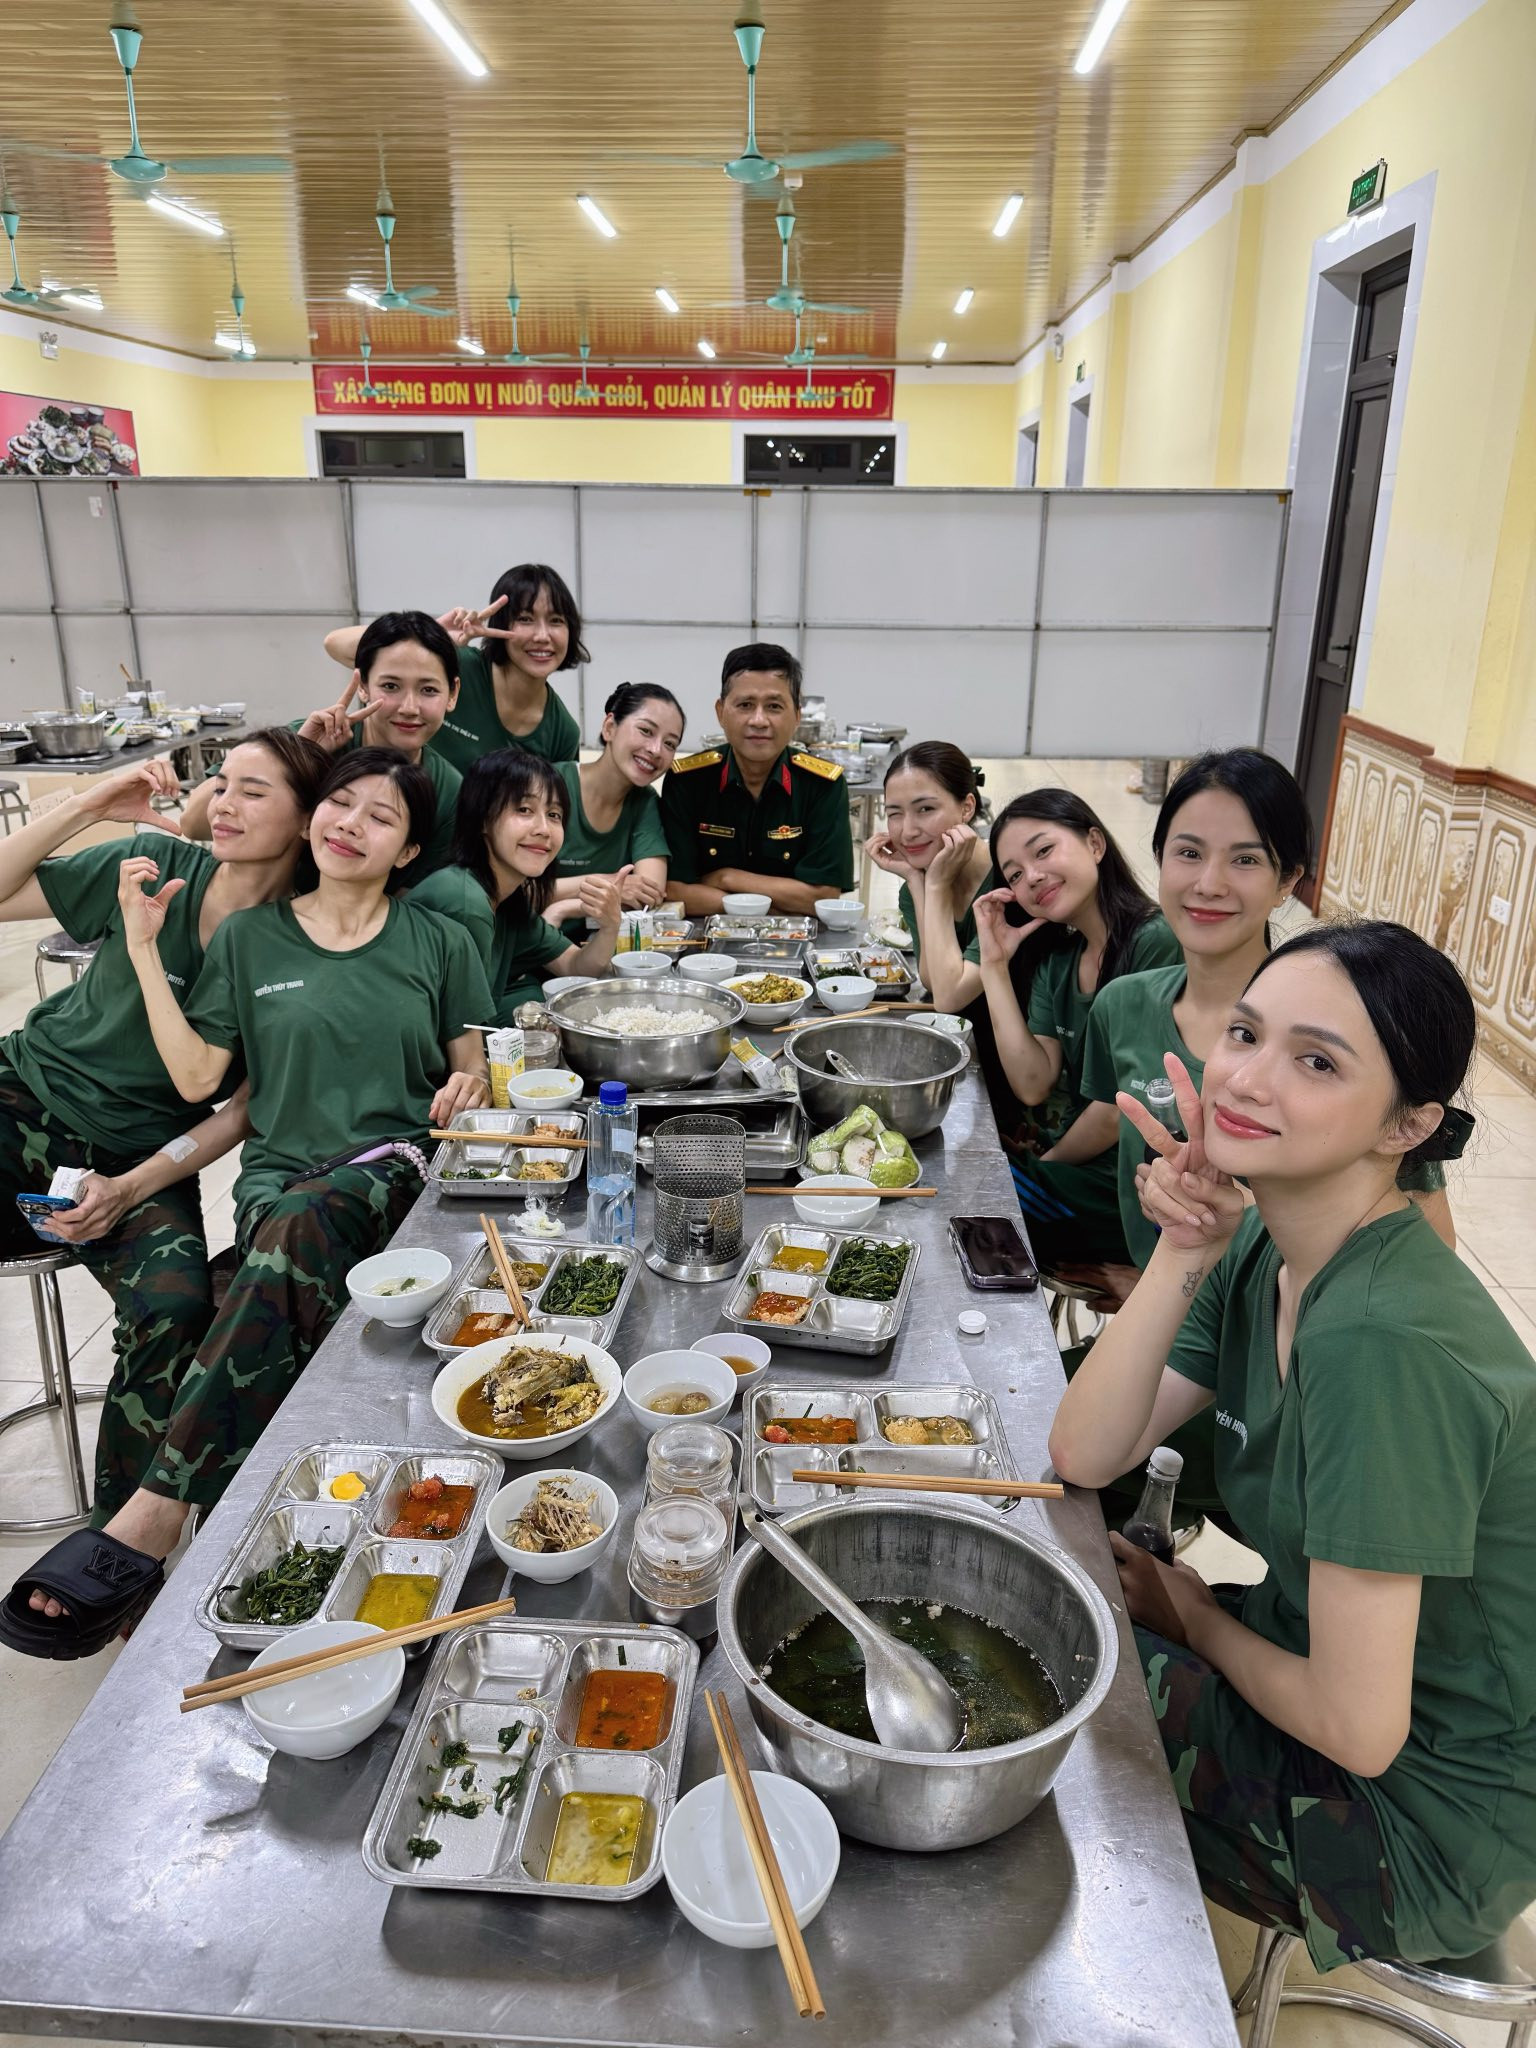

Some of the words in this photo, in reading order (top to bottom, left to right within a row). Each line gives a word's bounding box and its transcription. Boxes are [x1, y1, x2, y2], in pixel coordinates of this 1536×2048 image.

[430, 381, 470, 405] ĐƠN
[474, 382, 493, 410] VỊ
[498, 379, 543, 406] NUÔI
[653, 375, 705, 411] QUẢN
[710, 381, 734, 408] LÝ
[738, 383, 791, 411] QUÂN
[841, 378, 876, 409] TỐT
